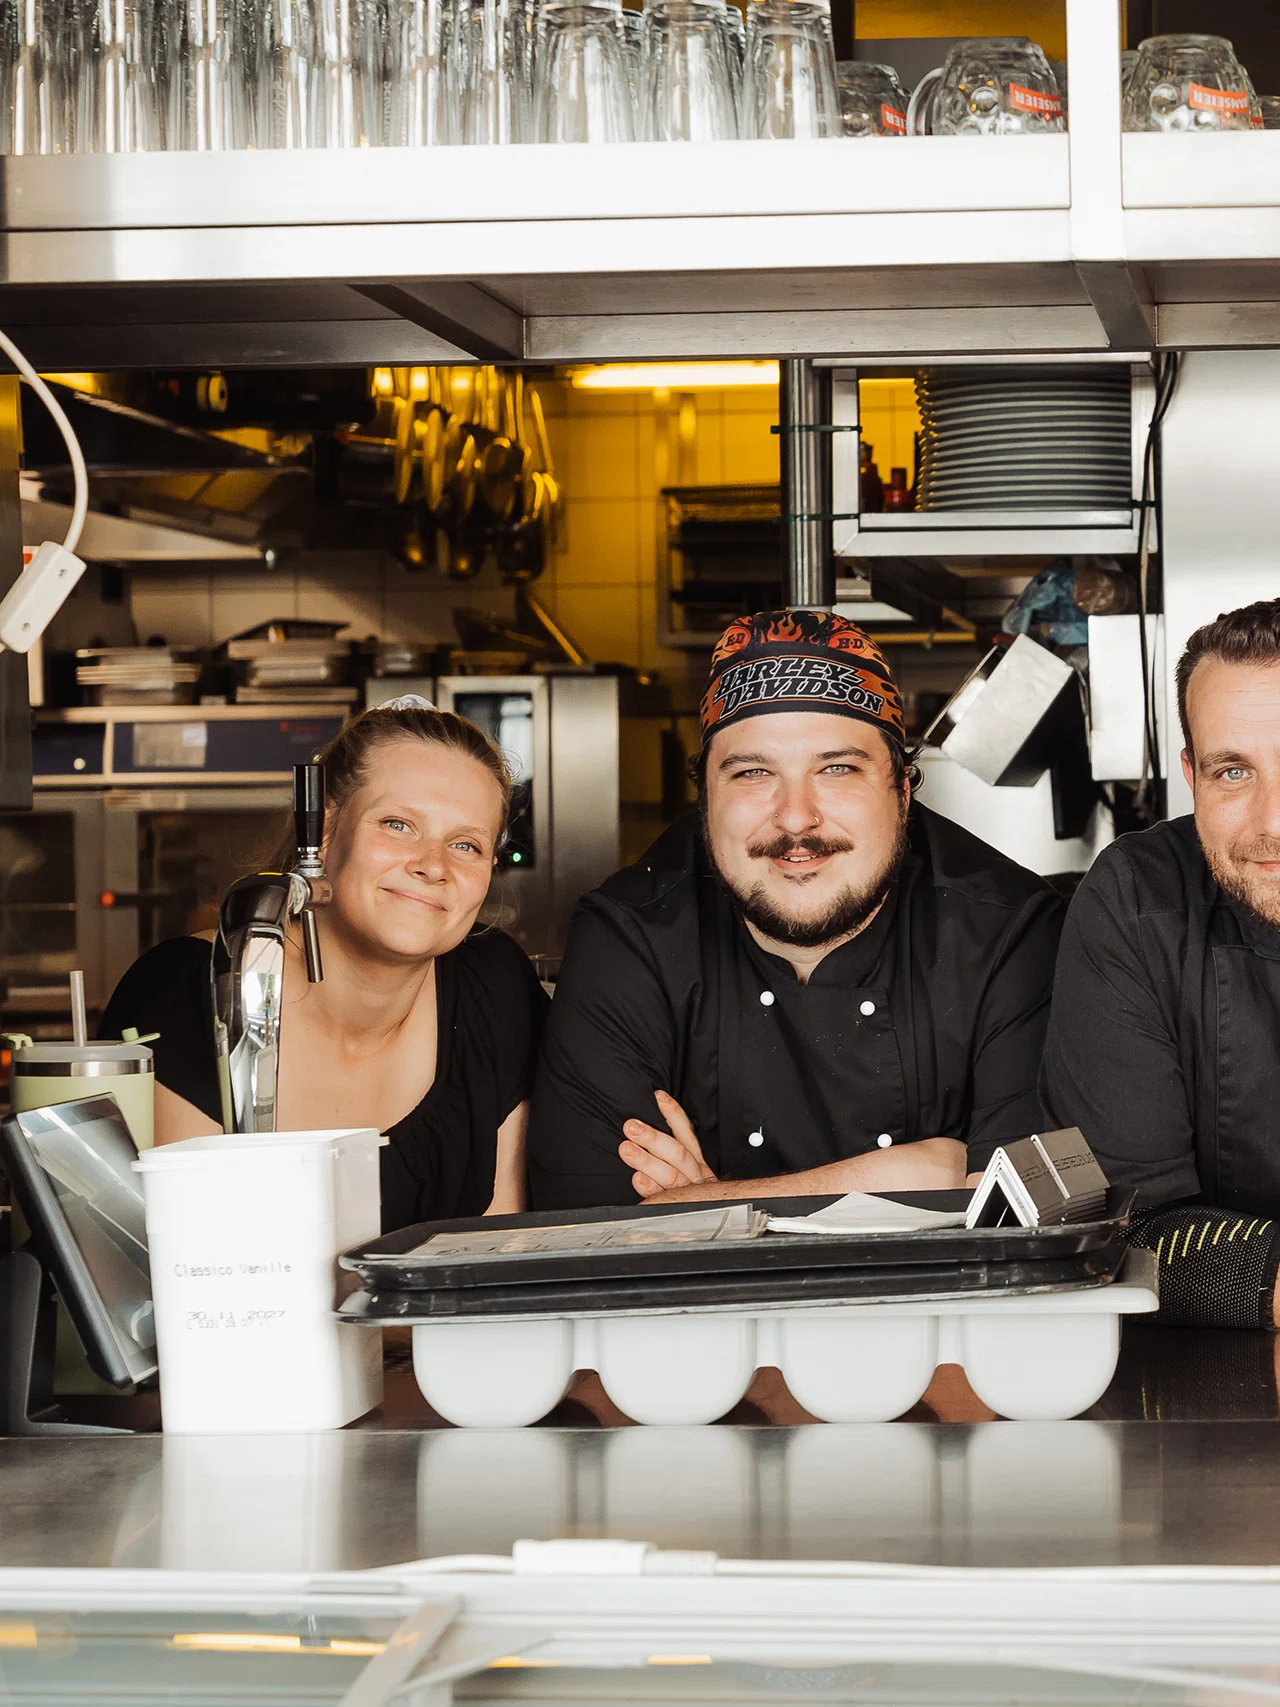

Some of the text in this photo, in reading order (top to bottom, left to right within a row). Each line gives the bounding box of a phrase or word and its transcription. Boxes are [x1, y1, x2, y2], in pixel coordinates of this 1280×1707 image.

[719, 676, 884, 719] DAVIDSON
[174, 1261, 292, 1278] Classico Vanille
